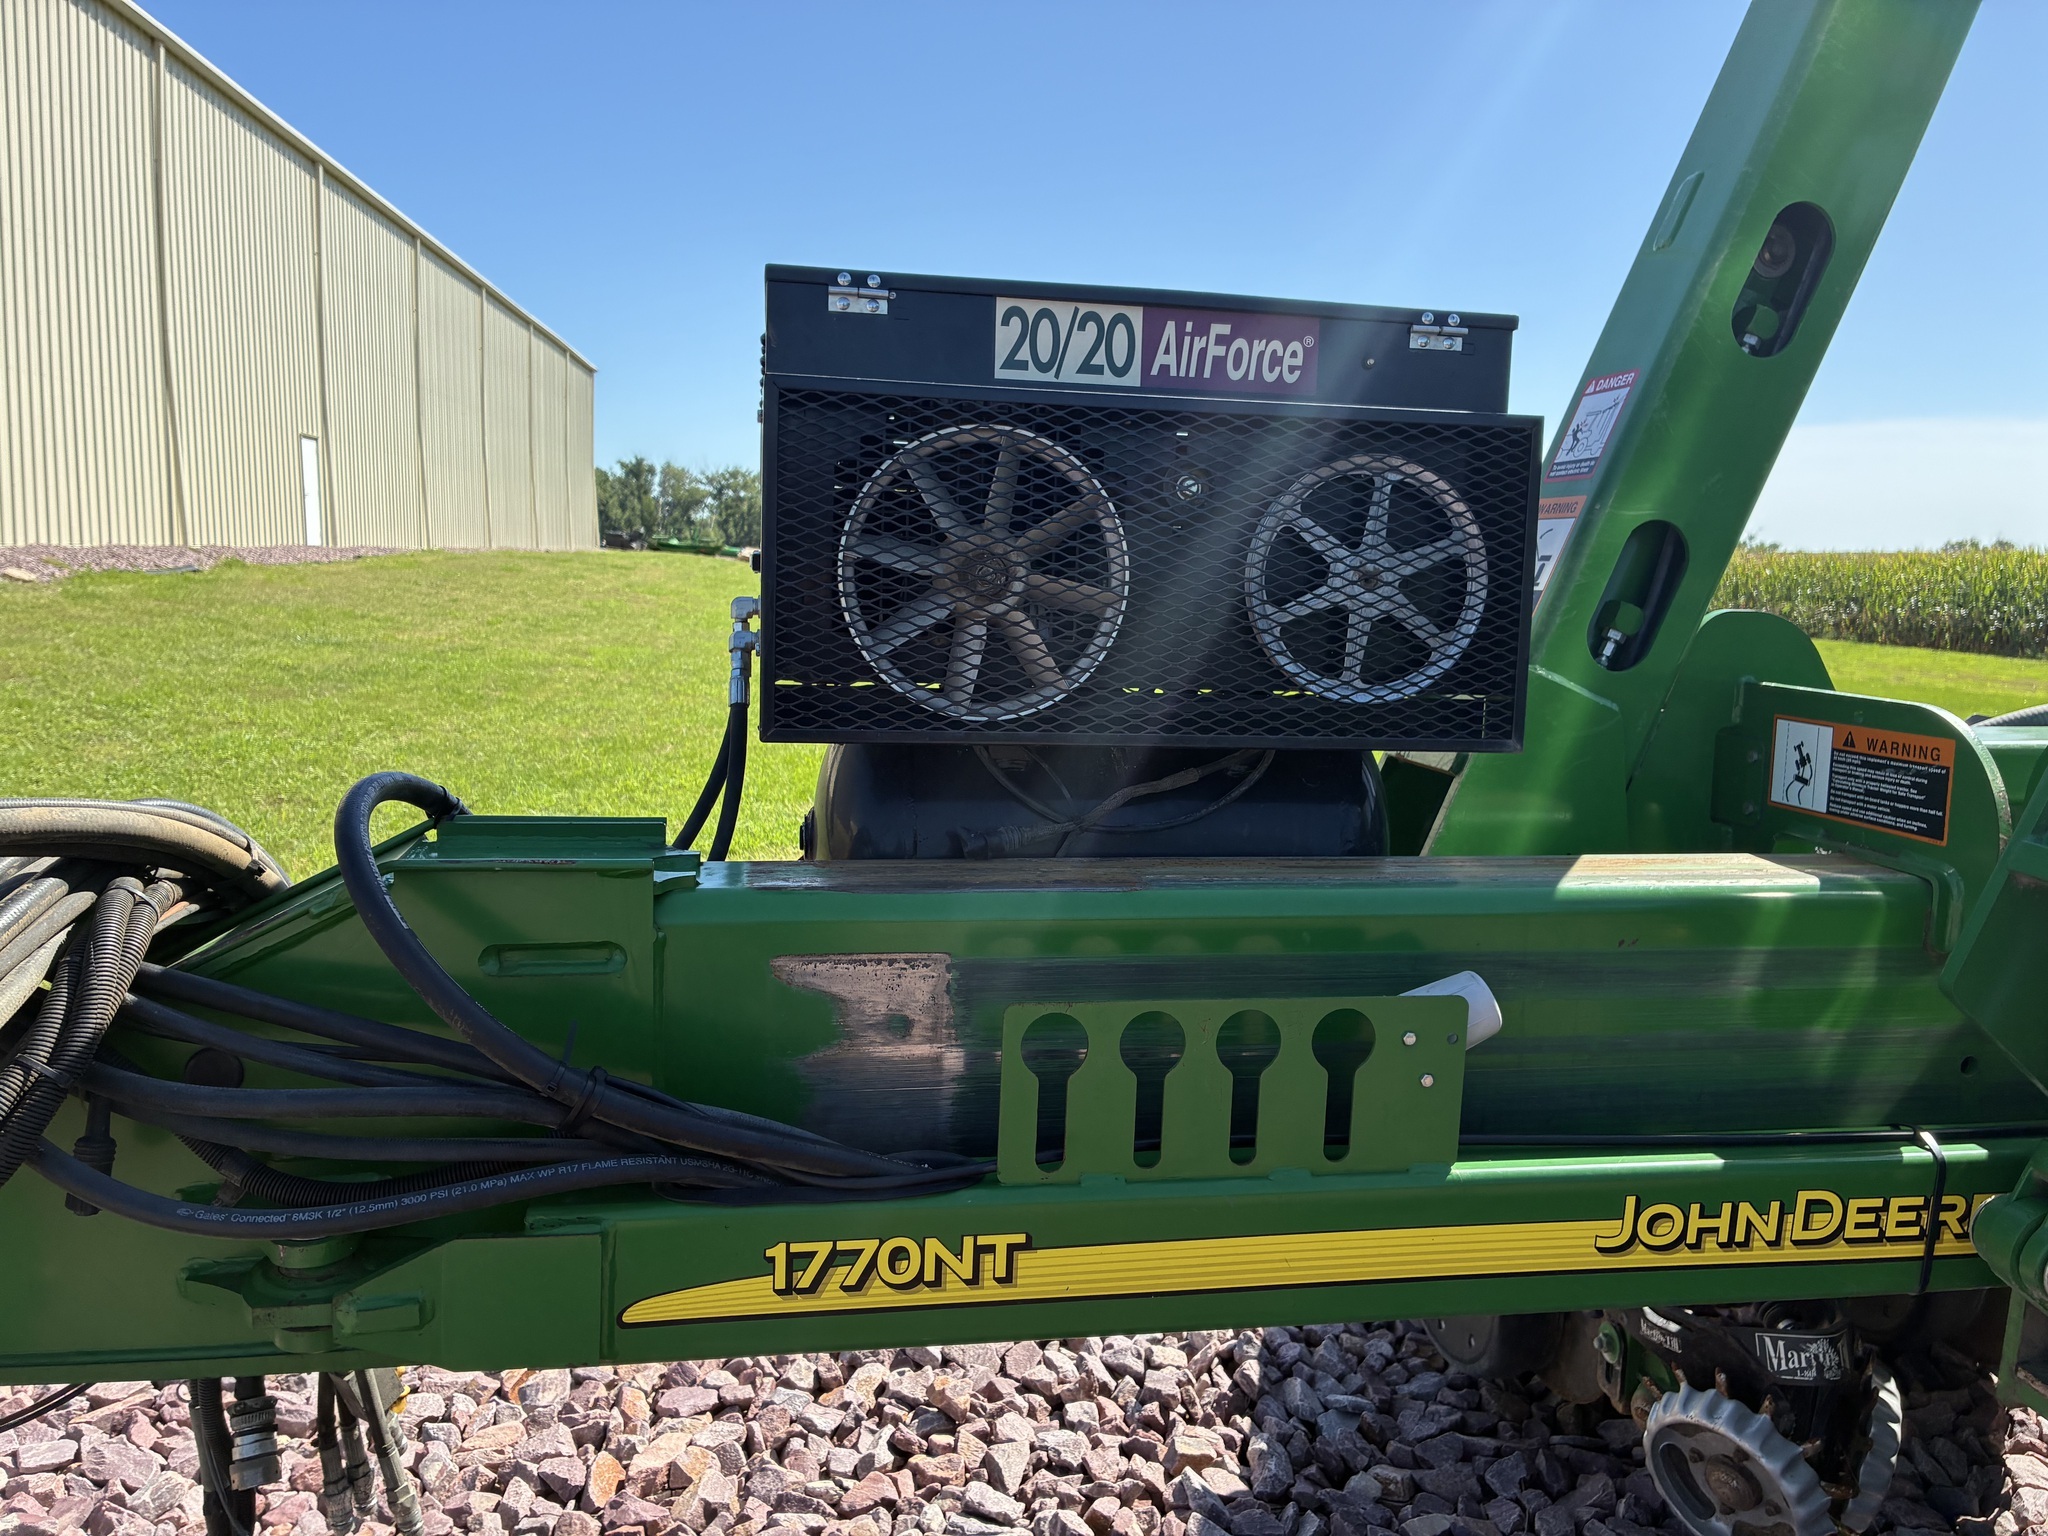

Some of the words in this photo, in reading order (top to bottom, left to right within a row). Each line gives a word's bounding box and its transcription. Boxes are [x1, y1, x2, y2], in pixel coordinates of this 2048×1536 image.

[999, 305, 1136, 380] 20/20
[1596, 372, 1635, 391] DANGER
[1866, 737, 1941, 762] WARNING
[349, 1199, 398, 1217] (12.5mm)
[401, 1193, 427, 1206] 3000
[430, 1189, 449, 1200] PSI
[451, 1183, 478, 1197] (21.0
[480, 1178, 507, 1191] MPa)
[510, 1172, 535, 1184] MAX
[537, 1168, 555, 1178] WP
[581, 1159, 619, 1171] FLAME
[620, 1157, 677, 1167] RESISTANT
[1790, 1188, 1996, 1246] DEER
[764, 1233, 1031, 1295] 1770NT
